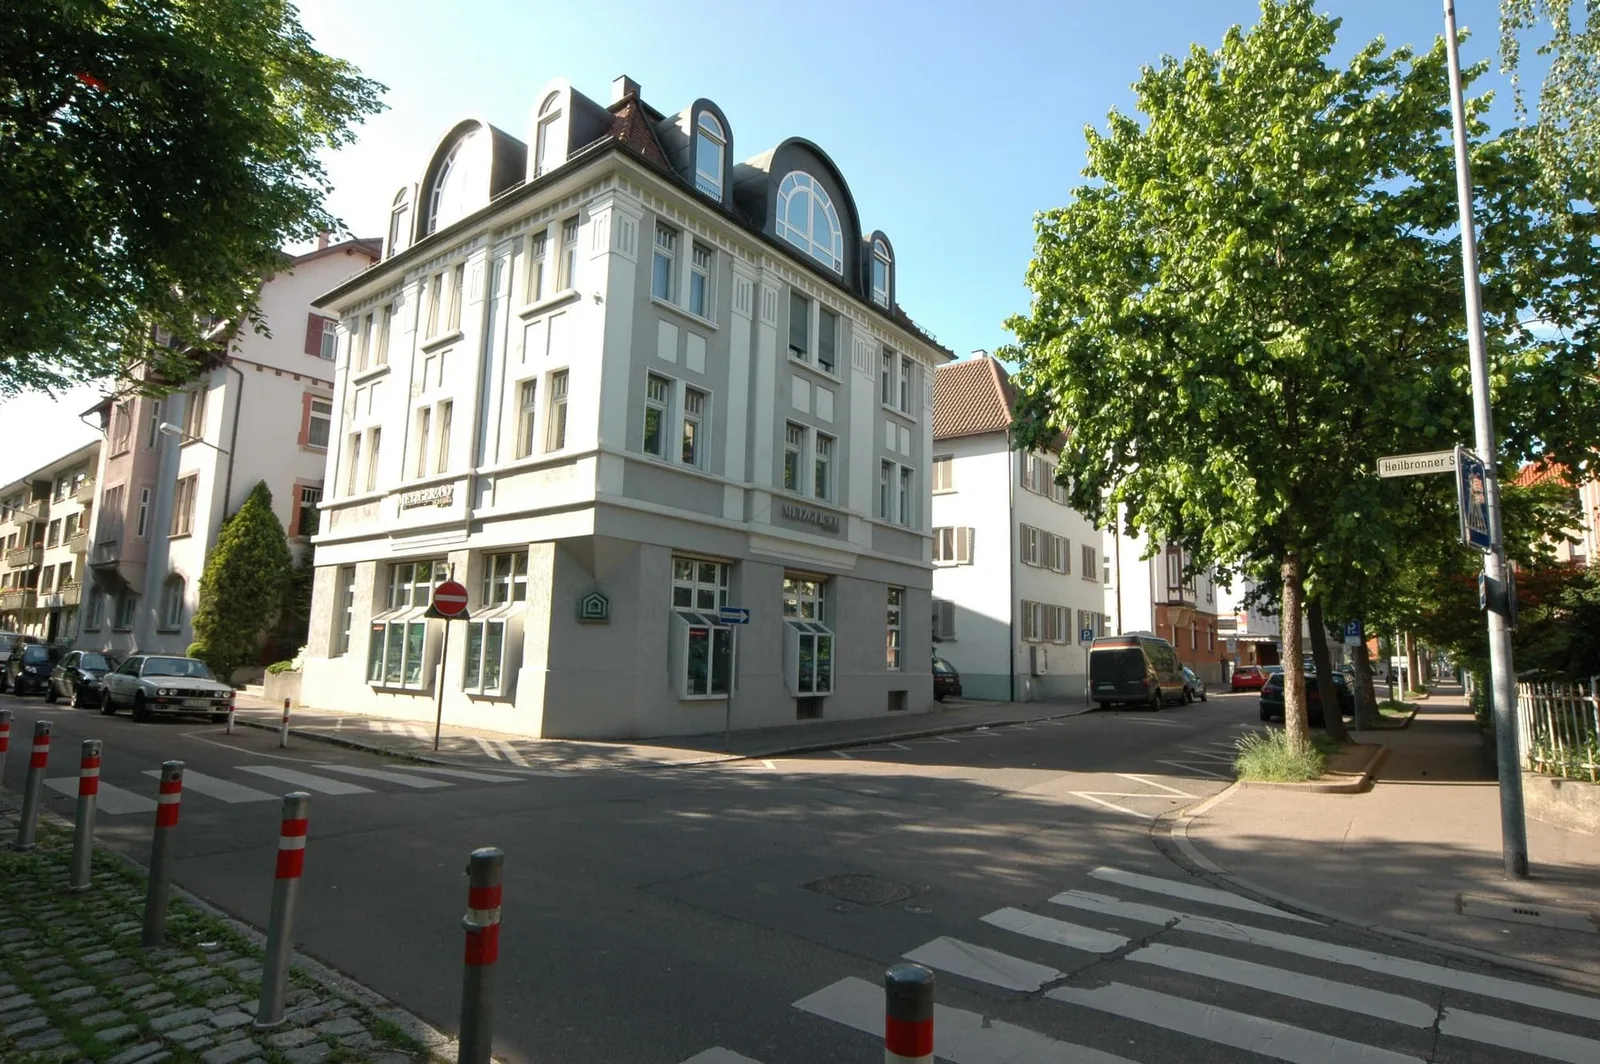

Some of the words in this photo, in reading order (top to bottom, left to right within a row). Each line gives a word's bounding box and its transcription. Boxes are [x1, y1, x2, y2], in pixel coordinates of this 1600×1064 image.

[1385, 458, 1445, 472] Heilbronner
[1449, 455, 1455, 466] S
[1083, 630, 1091, 640] P
[1347, 621, 1356, 635] P
